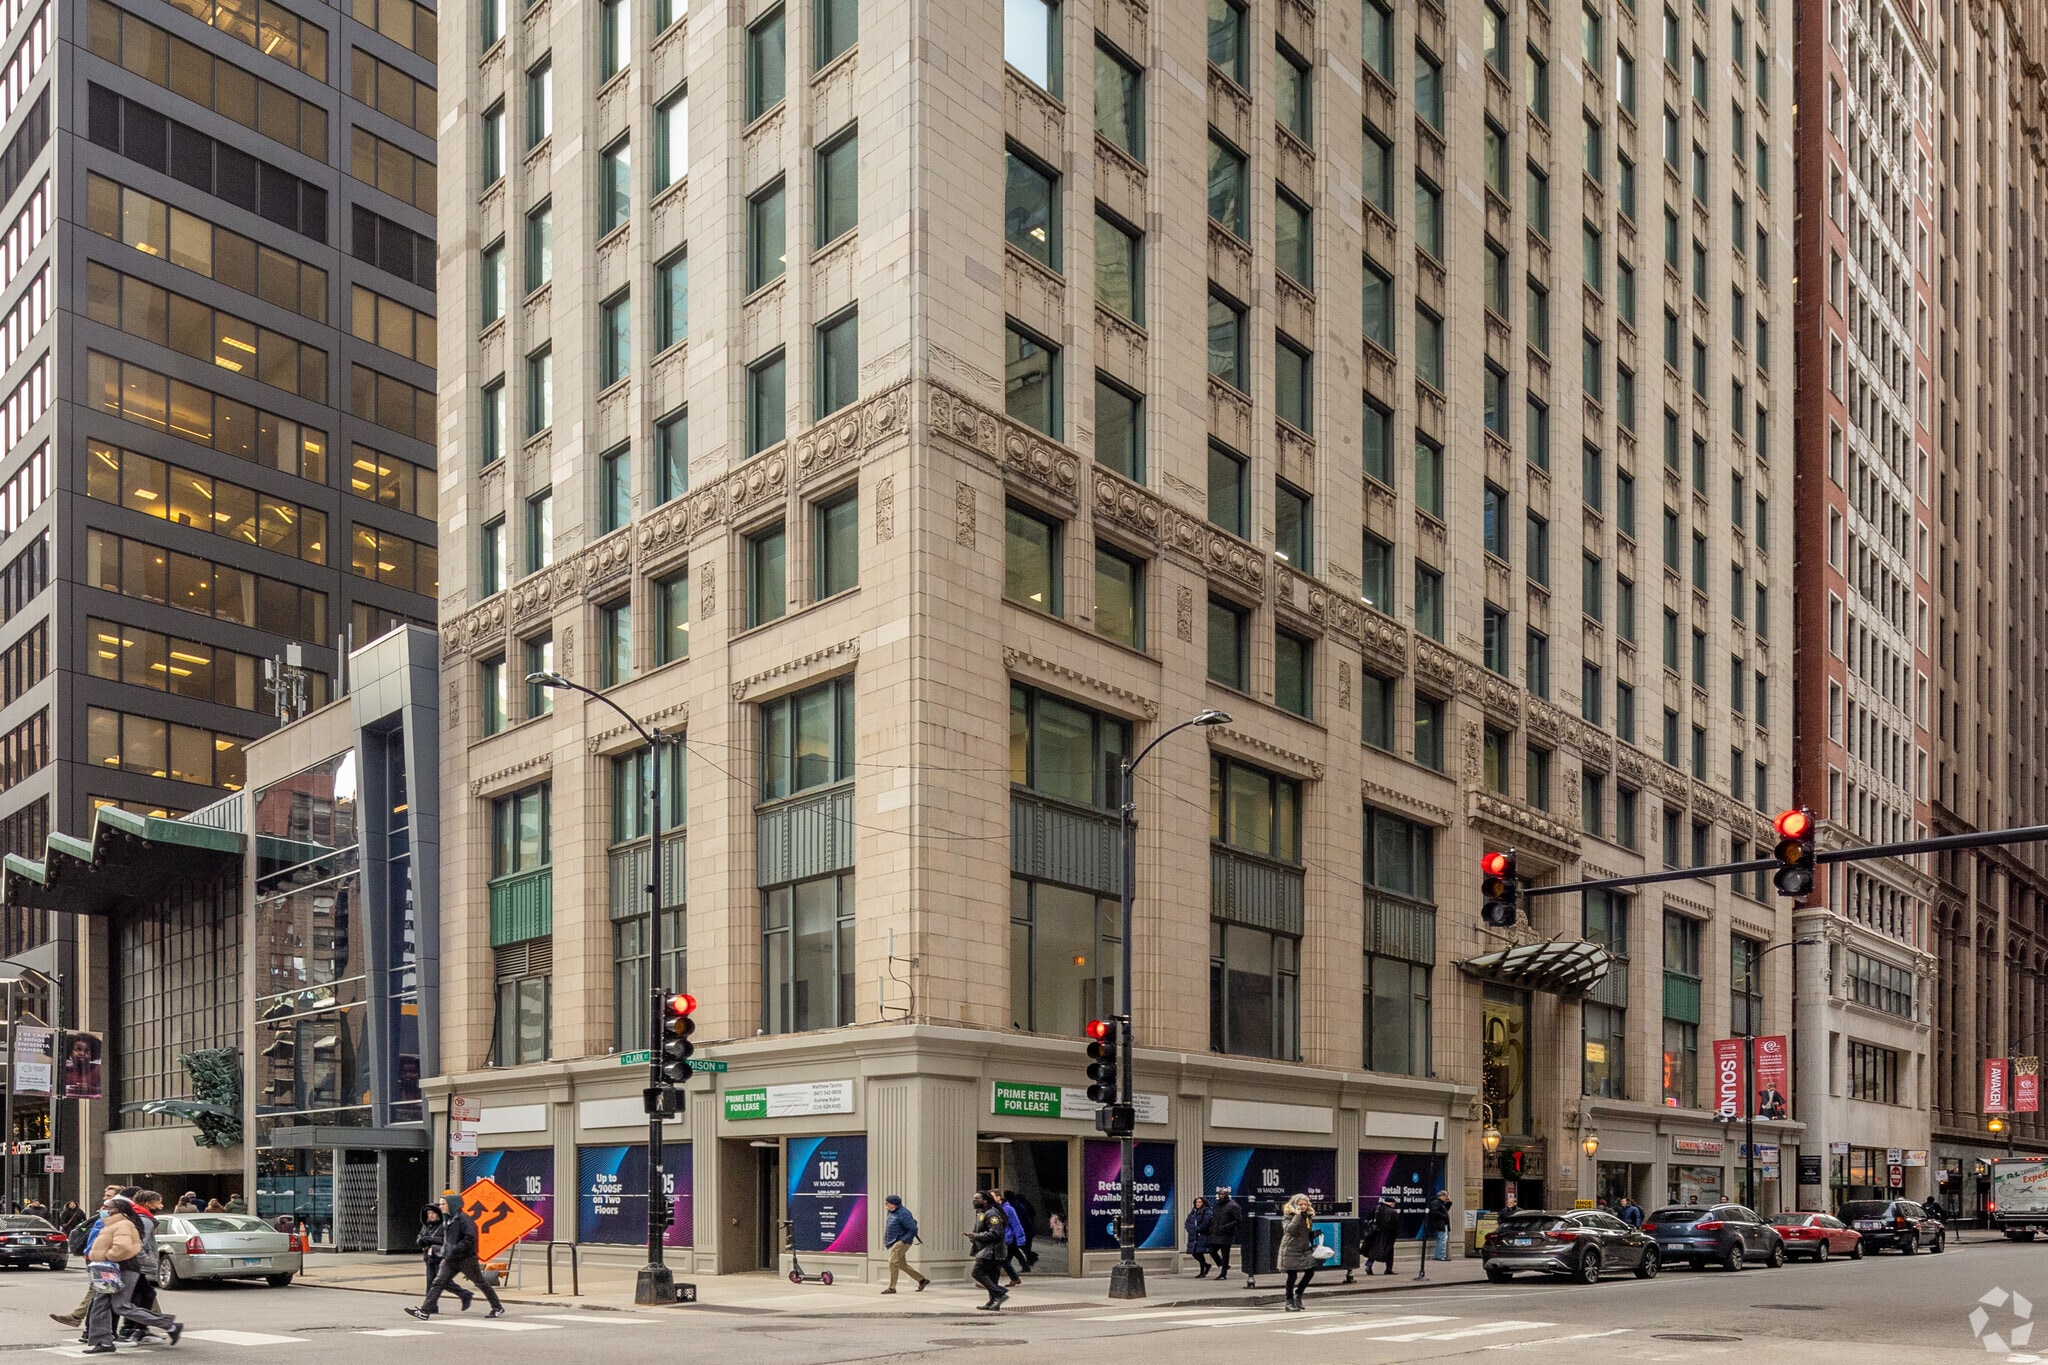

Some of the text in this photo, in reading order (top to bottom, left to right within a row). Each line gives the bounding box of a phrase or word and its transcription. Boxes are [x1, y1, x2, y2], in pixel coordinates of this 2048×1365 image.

[626, 1054, 644, 1064] CLARK
[689, 1061, 716, 1071] DISON
[1990, 1068, 2002, 1106] AWAKEN
[725, 1094, 744, 1103] PRIME
[745, 1092, 766, 1102] RETAIL
[997, 1088, 1058, 1102] PRIME RETAIL
[730, 1102, 760, 1112] FOR LEASE
[1004, 1100, 1050, 1112] FOR LEASE
[819, 1162, 838, 1180] 105
[596, 1174, 618, 1184] Up to
[1262, 1168, 1280, 1186] 105
[526, 1176, 541, 1194] 105
[592, 1184, 622, 1194] 4,700SF
[1098, 1180, 1160, 1193] Reta Space
[1382, 1186, 1422, 1196] Retail Space
[604, 1196, 621, 1204] Two
[1093, 1193, 1122, 1202] Availab
[1144, 1194, 1166, 1202] Lease
[594, 1206, 618, 1214] Floors
